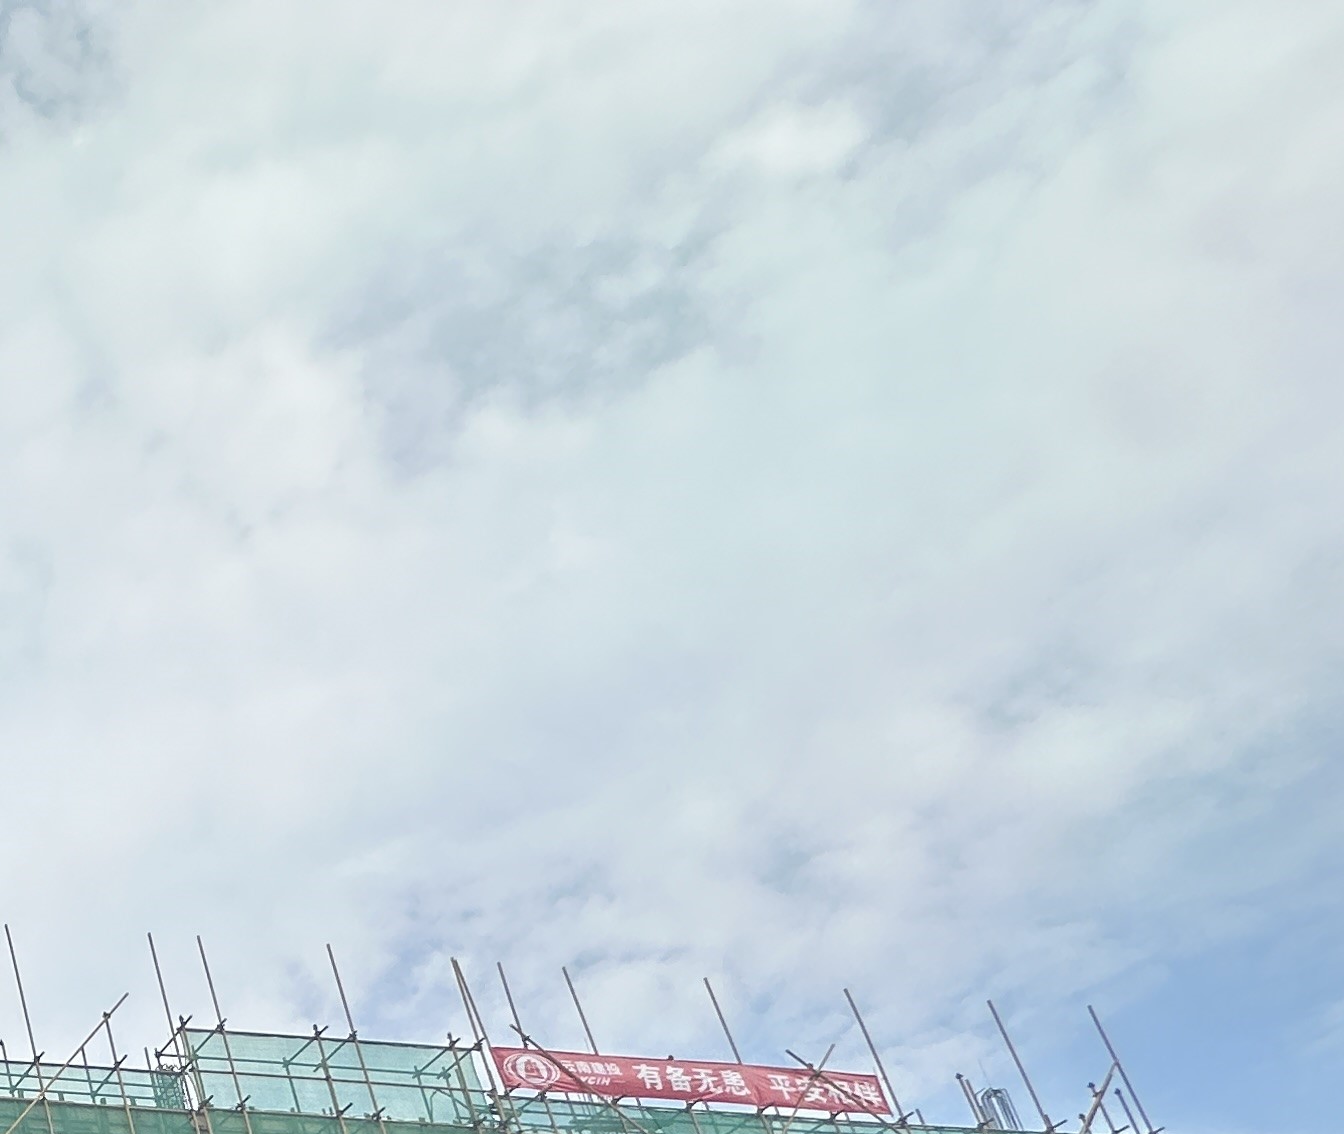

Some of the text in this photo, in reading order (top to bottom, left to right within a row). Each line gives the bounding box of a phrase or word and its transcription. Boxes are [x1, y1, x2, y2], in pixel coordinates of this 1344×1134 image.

[632, 1063, 883, 1105] 有备无患 平安相伴
